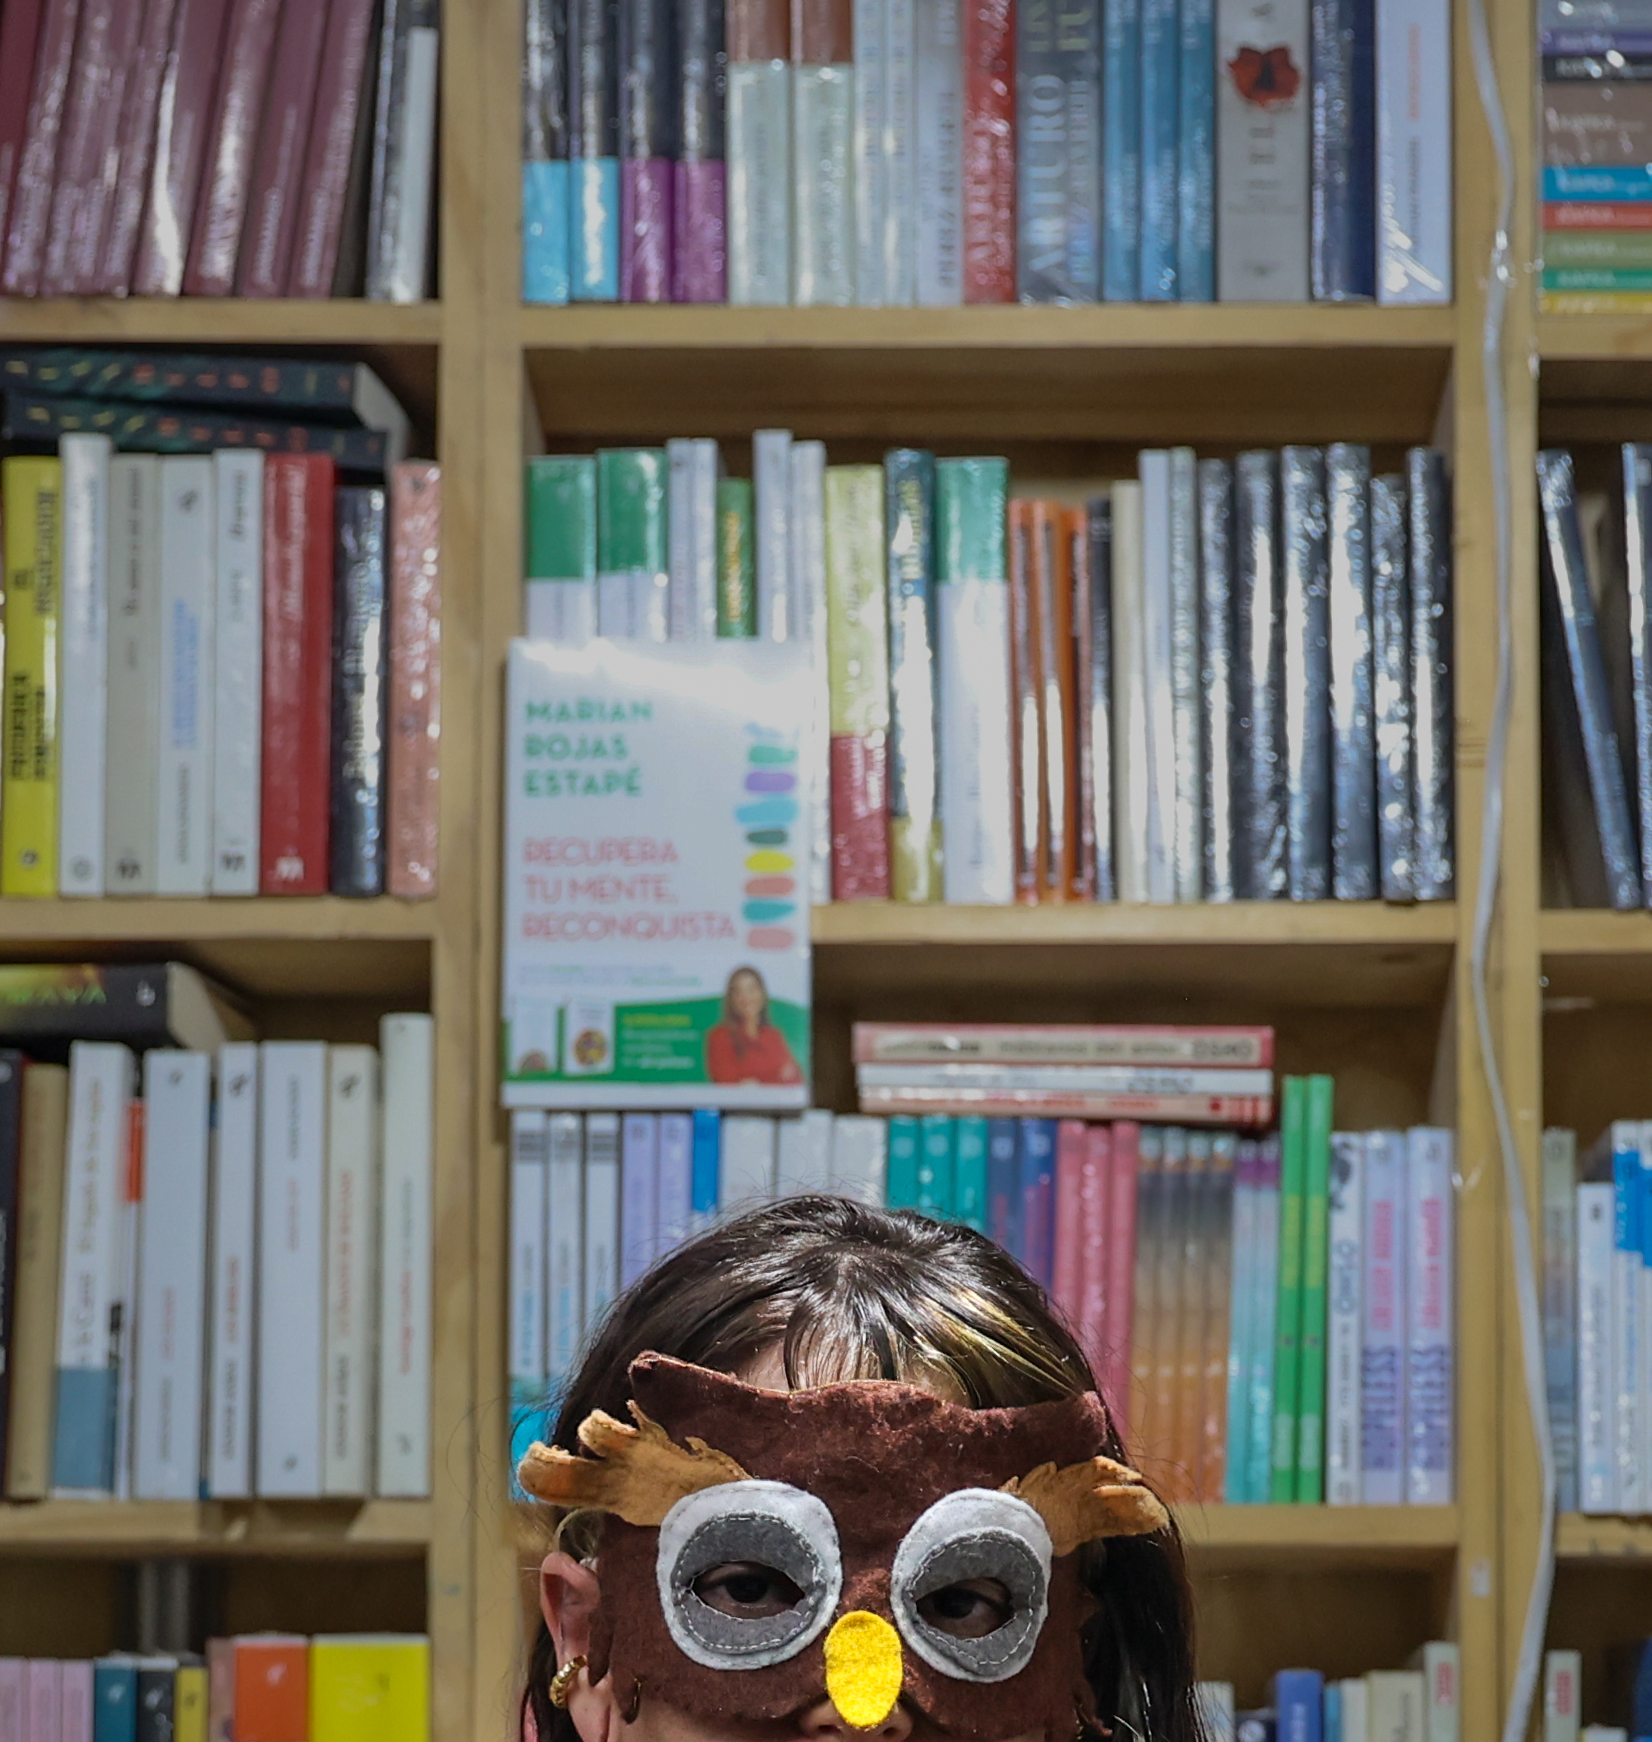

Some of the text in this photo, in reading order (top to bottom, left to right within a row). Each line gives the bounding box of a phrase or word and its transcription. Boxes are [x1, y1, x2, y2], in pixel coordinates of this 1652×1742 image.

[1025, 74, 1067, 272] ARTURO
[524, 697, 654, 723] MARIAN
[523, 732, 628, 761] ROJAS
[522, 761, 643, 798] ESTAPÉ
[522, 836, 680, 867] RECUPERA
[524, 873, 563, 904] TU
[521, 910, 738, 942] RECONQUISTA
